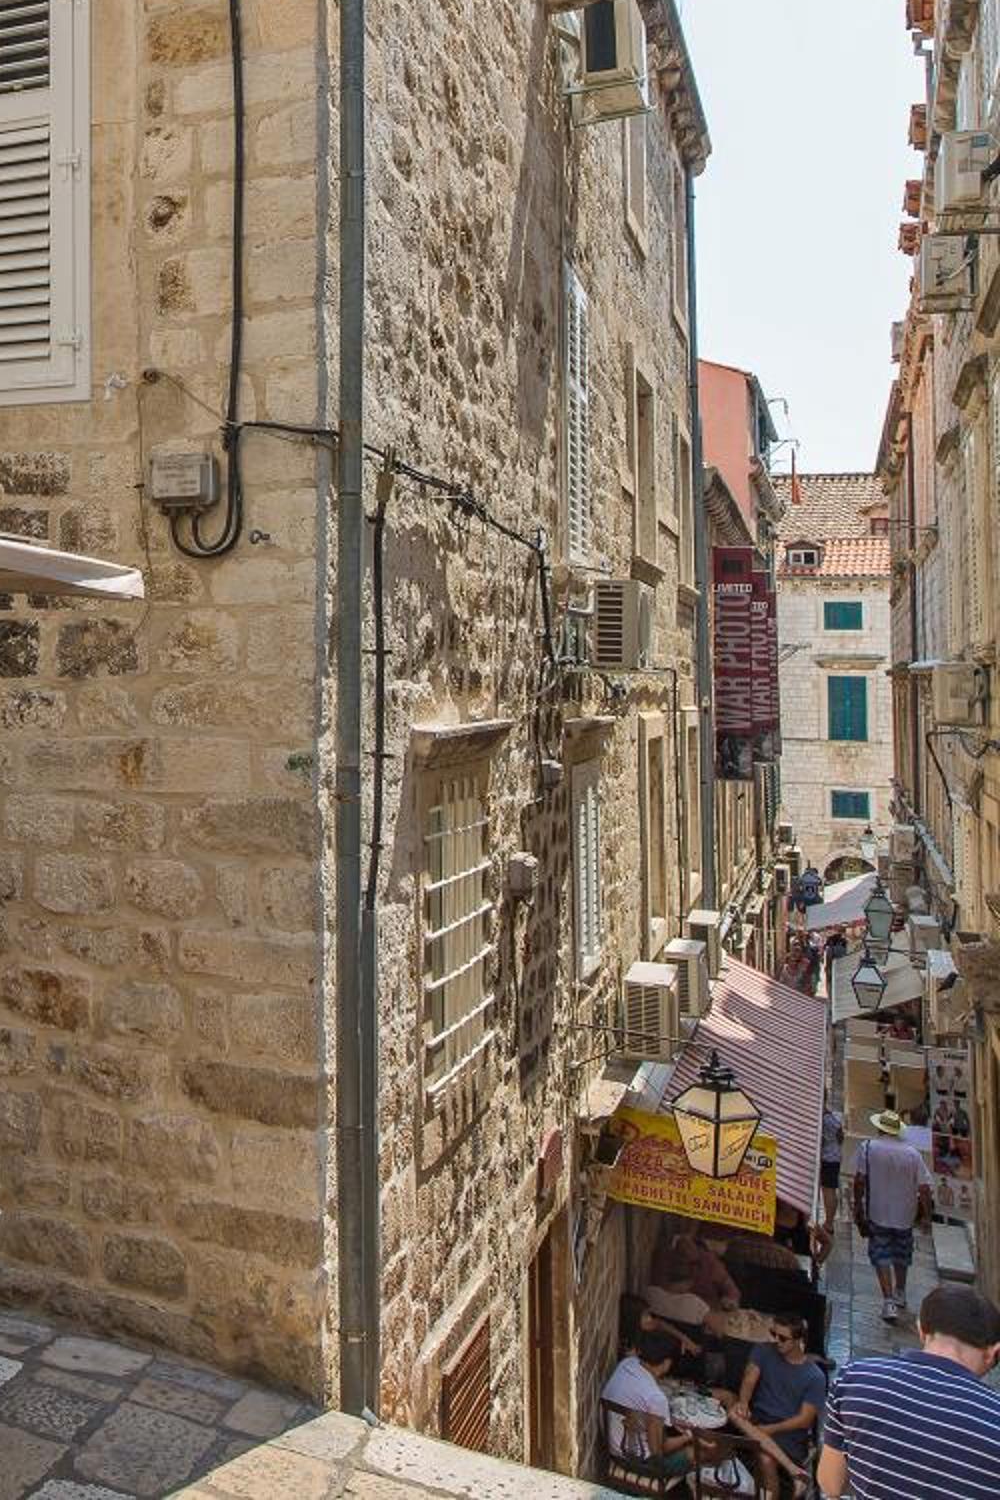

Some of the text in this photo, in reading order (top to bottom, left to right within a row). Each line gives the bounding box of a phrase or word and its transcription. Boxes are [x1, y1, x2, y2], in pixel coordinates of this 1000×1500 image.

[713, 583, 752, 593] LIMITED
[716, 594, 751, 729] WAR PHOTO
[708, 1187, 764, 1206] SALADS
[693, 1197, 771, 1223] SANDWICH
